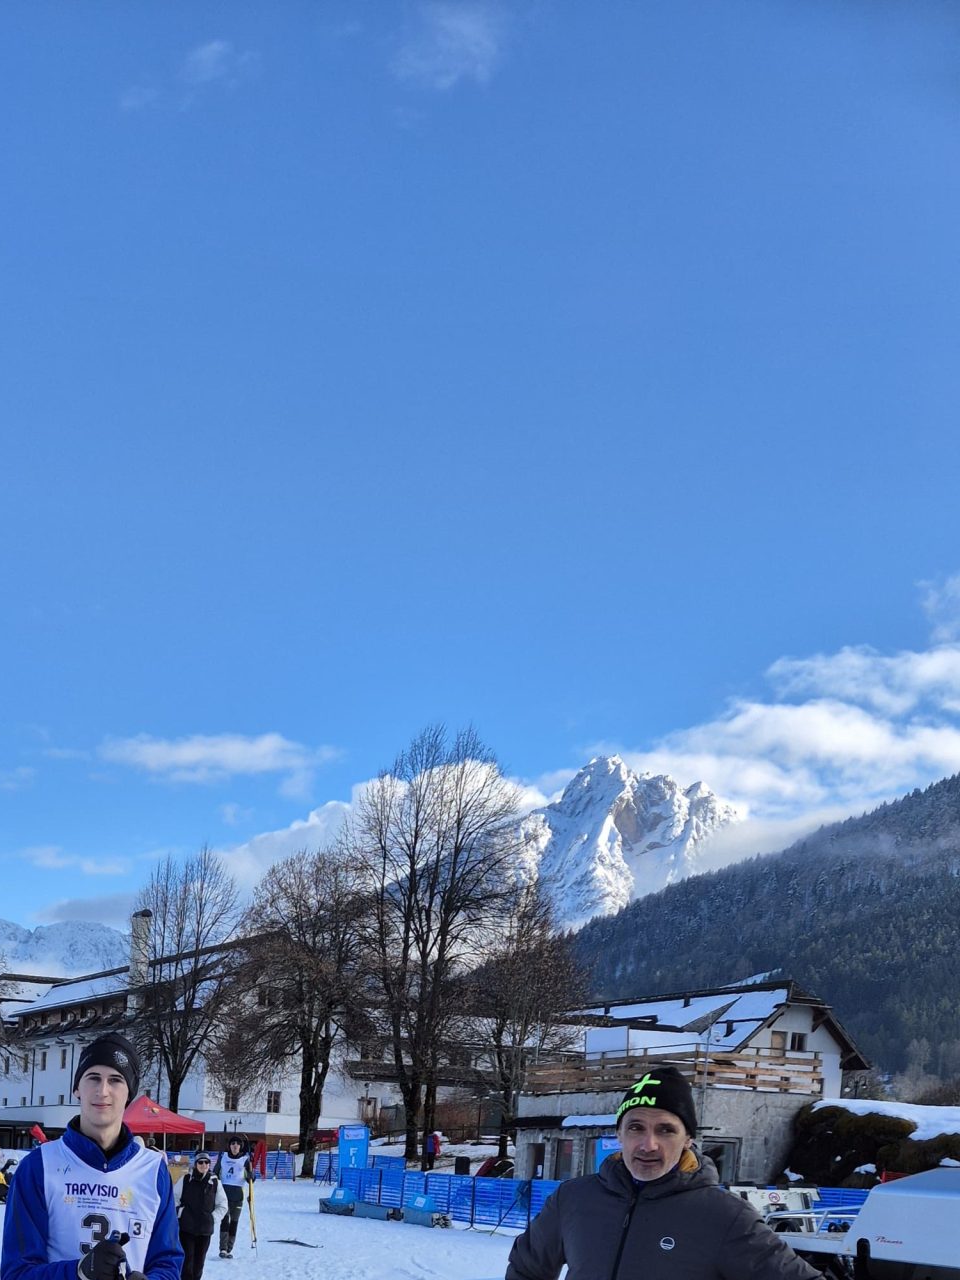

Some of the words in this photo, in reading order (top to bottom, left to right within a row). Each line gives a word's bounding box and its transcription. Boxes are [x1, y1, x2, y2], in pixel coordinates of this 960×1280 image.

[228, 1166, 234, 1174] 4
[65, 1183, 119, 1198] TARVISIO
[132, 1222, 142, 1235] 3
